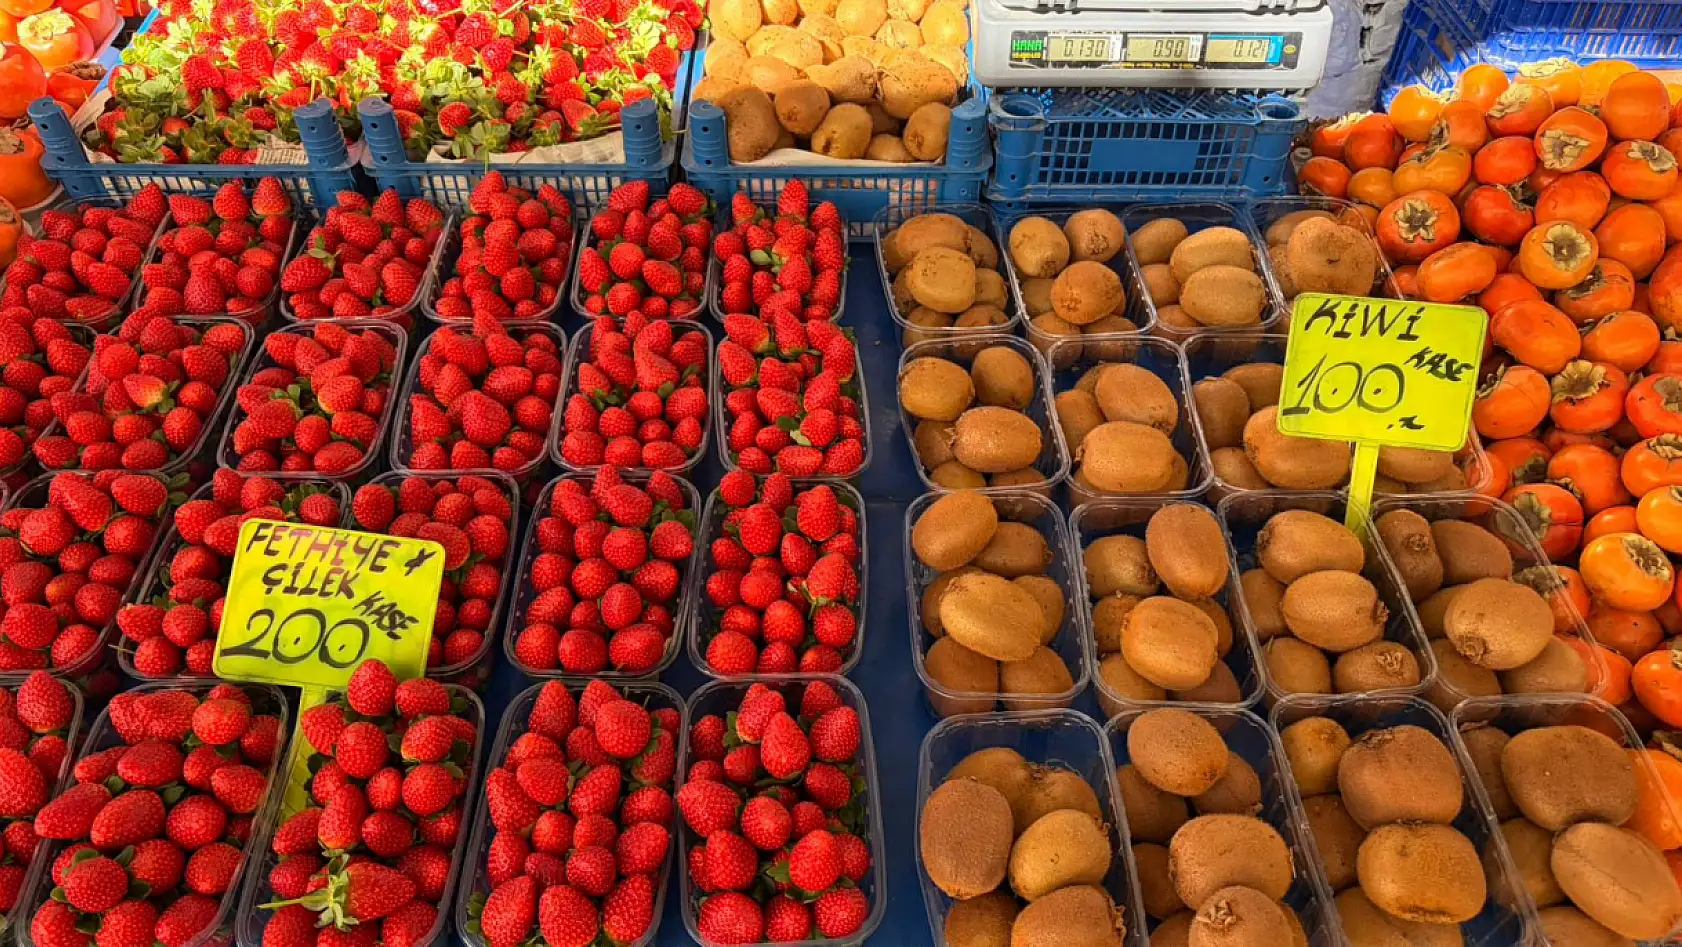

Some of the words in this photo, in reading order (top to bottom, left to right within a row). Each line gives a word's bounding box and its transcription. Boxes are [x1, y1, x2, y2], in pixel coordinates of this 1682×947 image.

[1063, 39, 1106, 58] 0.130
[1152, 39, 1185, 58] 0.90
[1282, 353, 1405, 416] 100
[262, 562, 360, 599] ÇİLEK
[220, 608, 370, 669] 200
